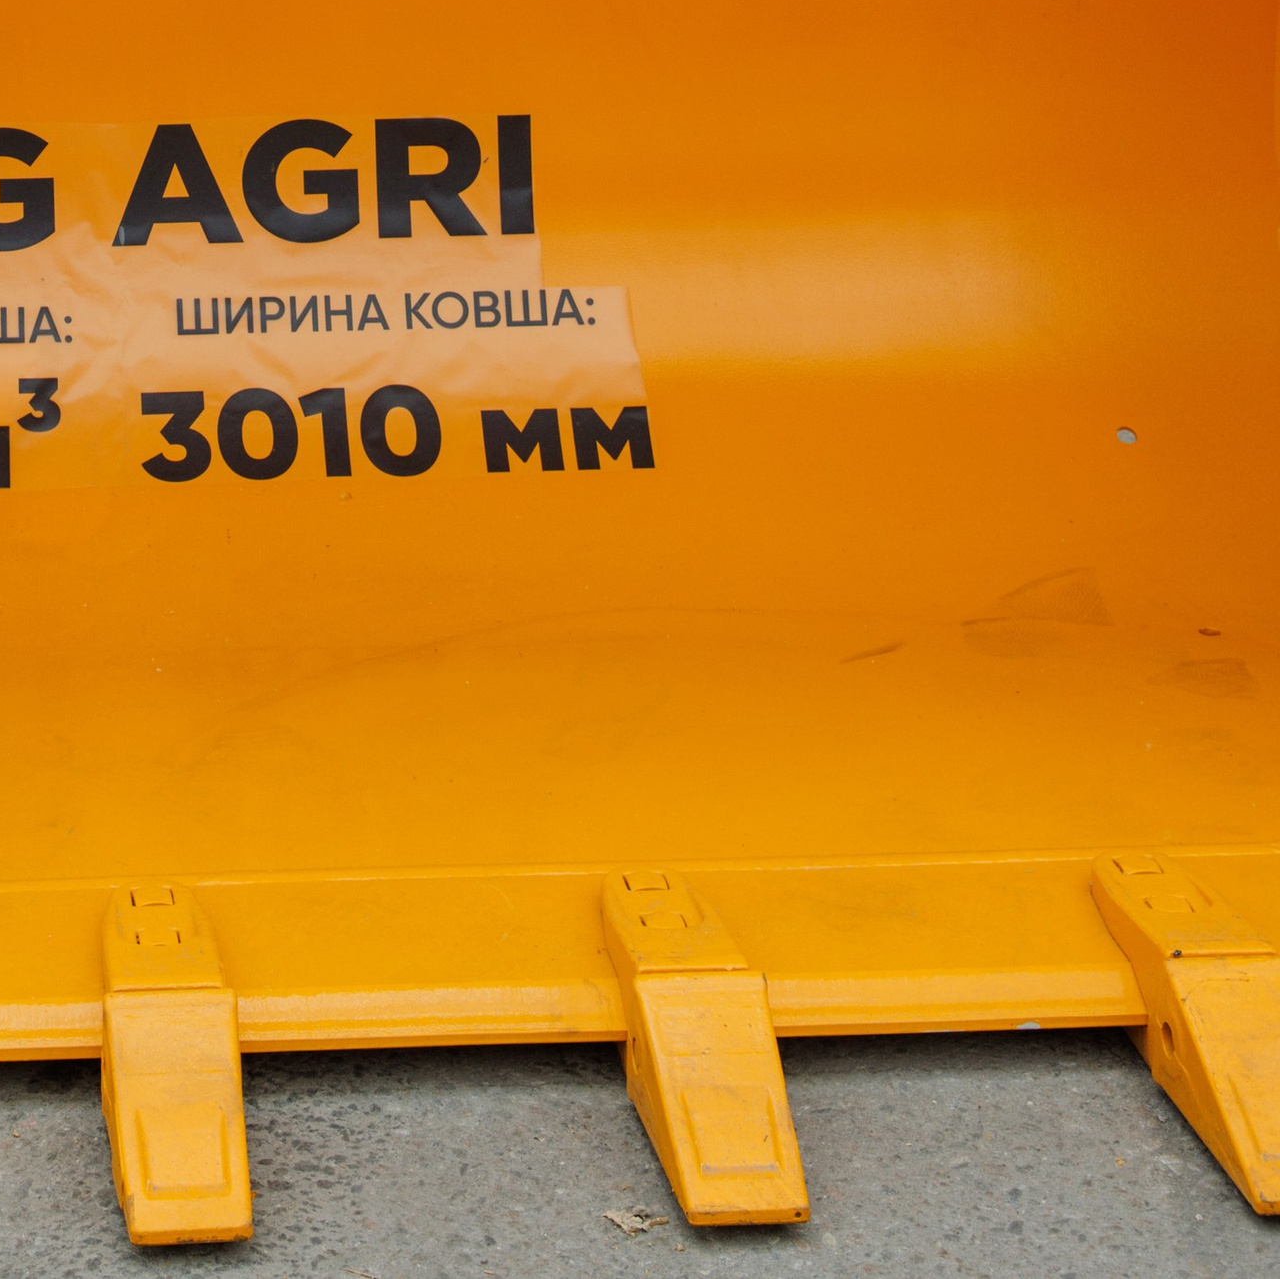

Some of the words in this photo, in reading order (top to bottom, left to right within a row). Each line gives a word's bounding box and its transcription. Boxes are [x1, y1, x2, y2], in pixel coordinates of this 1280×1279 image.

[112, 114, 535, 247] AGRI
[176, 293, 390, 336] ШИРИНА
[404, 288, 596, 331] КОВША:
[141, 384, 442, 483] 3010
[480, 405, 656, 474] мм
